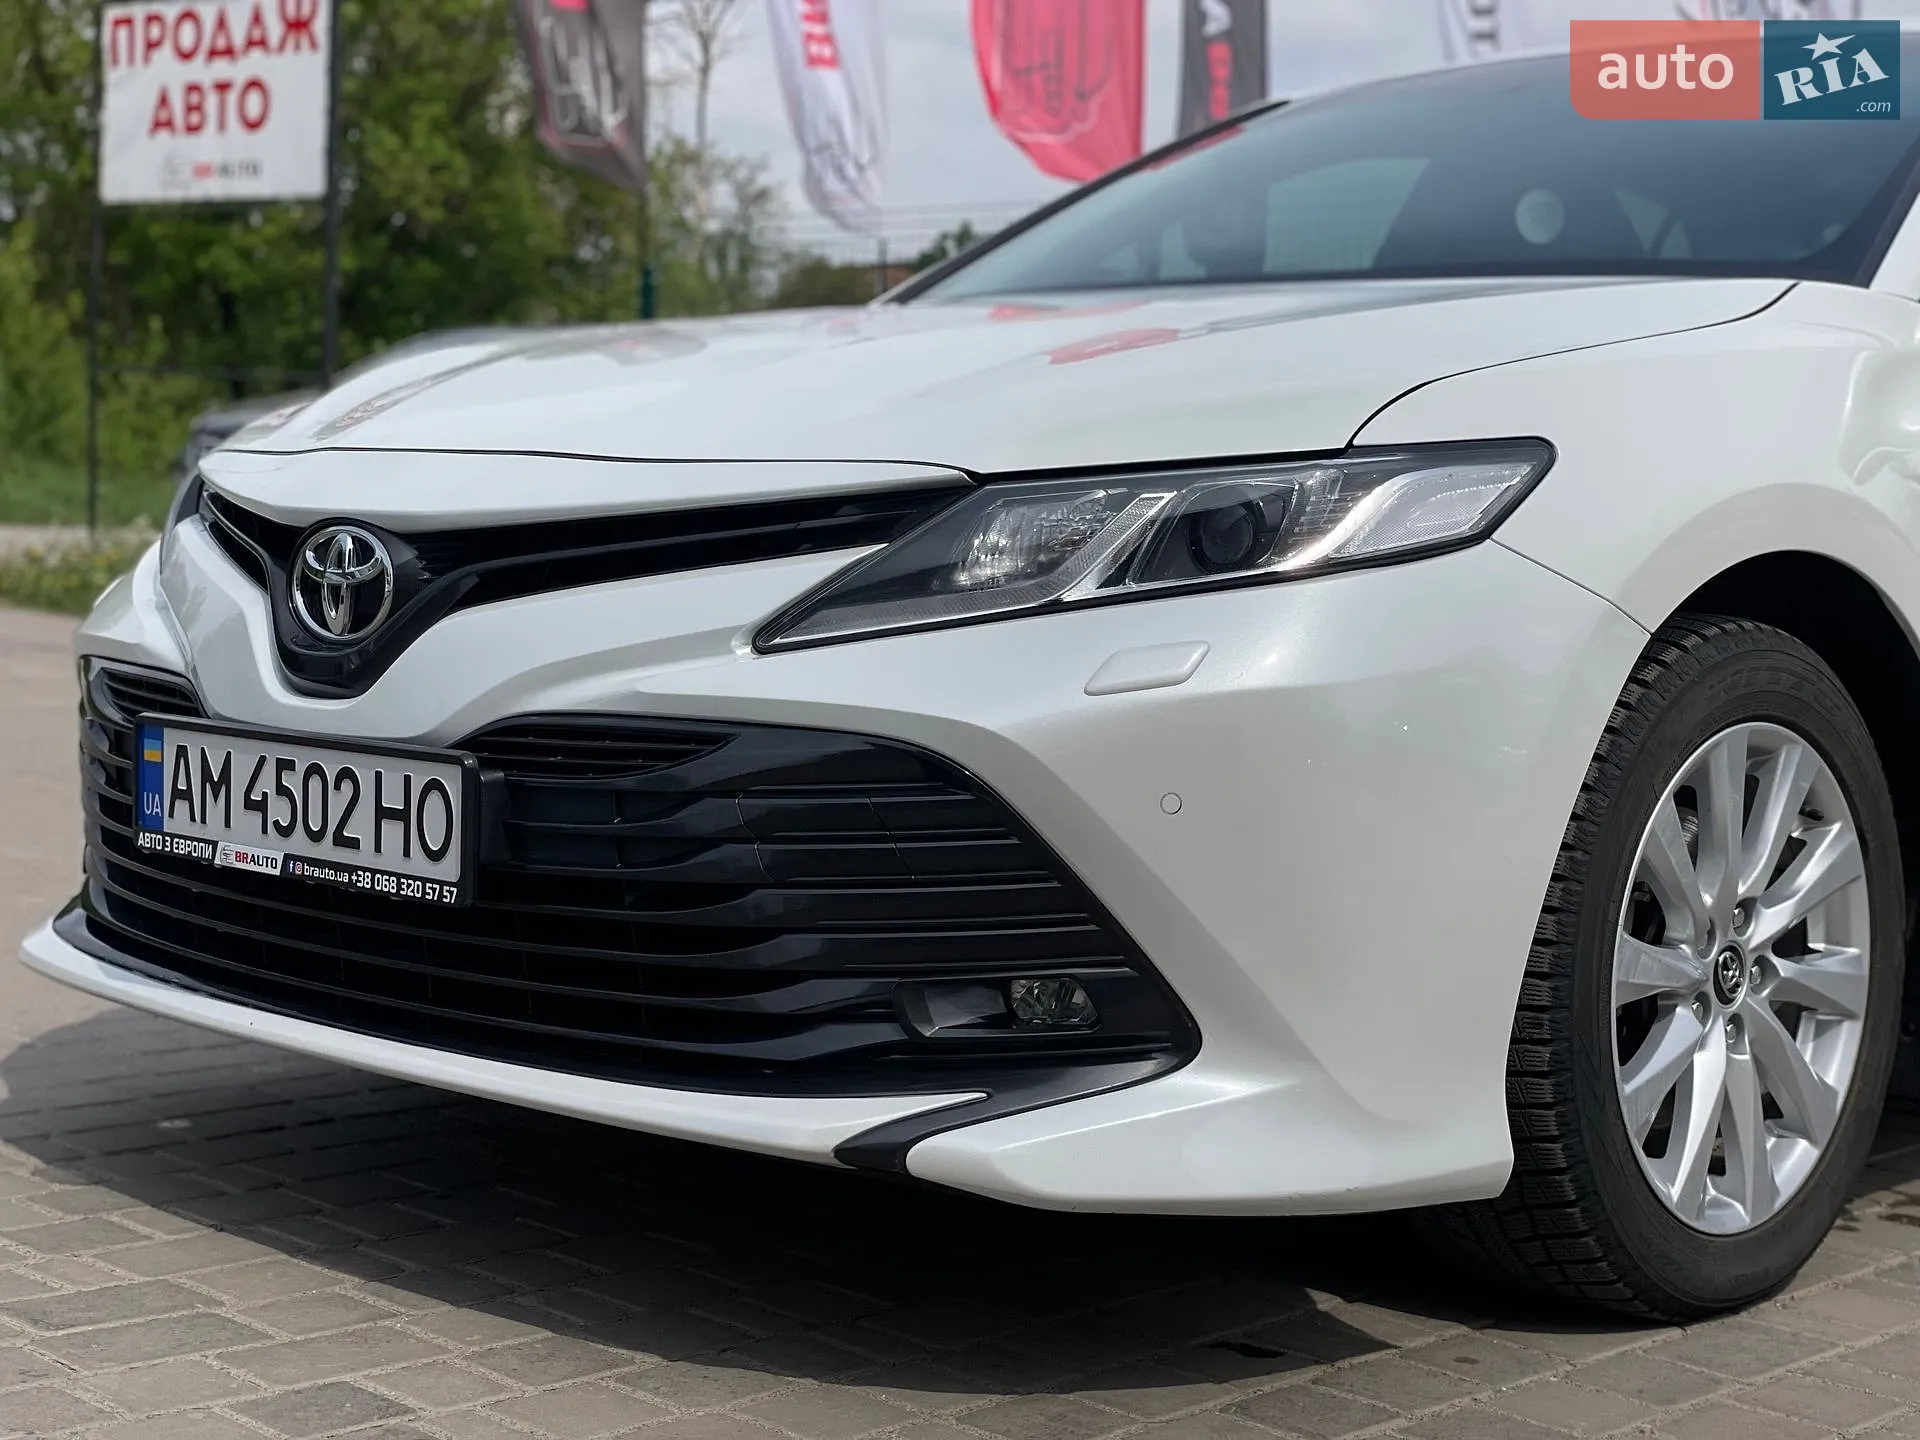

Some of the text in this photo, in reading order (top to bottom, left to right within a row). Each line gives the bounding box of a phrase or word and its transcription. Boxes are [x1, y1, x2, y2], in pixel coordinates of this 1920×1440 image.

[110, 0, 319, 68] ПРОДАЖ
[149, 75, 270, 138] АВТО
[144, 791, 162, 816] UA
[168, 744, 453, 862] AM 4502 HO
[138, 831, 163, 850] АВТО
[173, 838, 212, 859] ЄВРОПИ
[234, 851, 278, 869] BRAUTO
[304, 865, 349, 882] brauto.ua
[351, 870, 372, 888] +38
[374, 874, 397, 893] 068
[400, 879, 422, 897] 320
[425, 883, 440, 900] 57
[442, 885, 458, 904] 57
